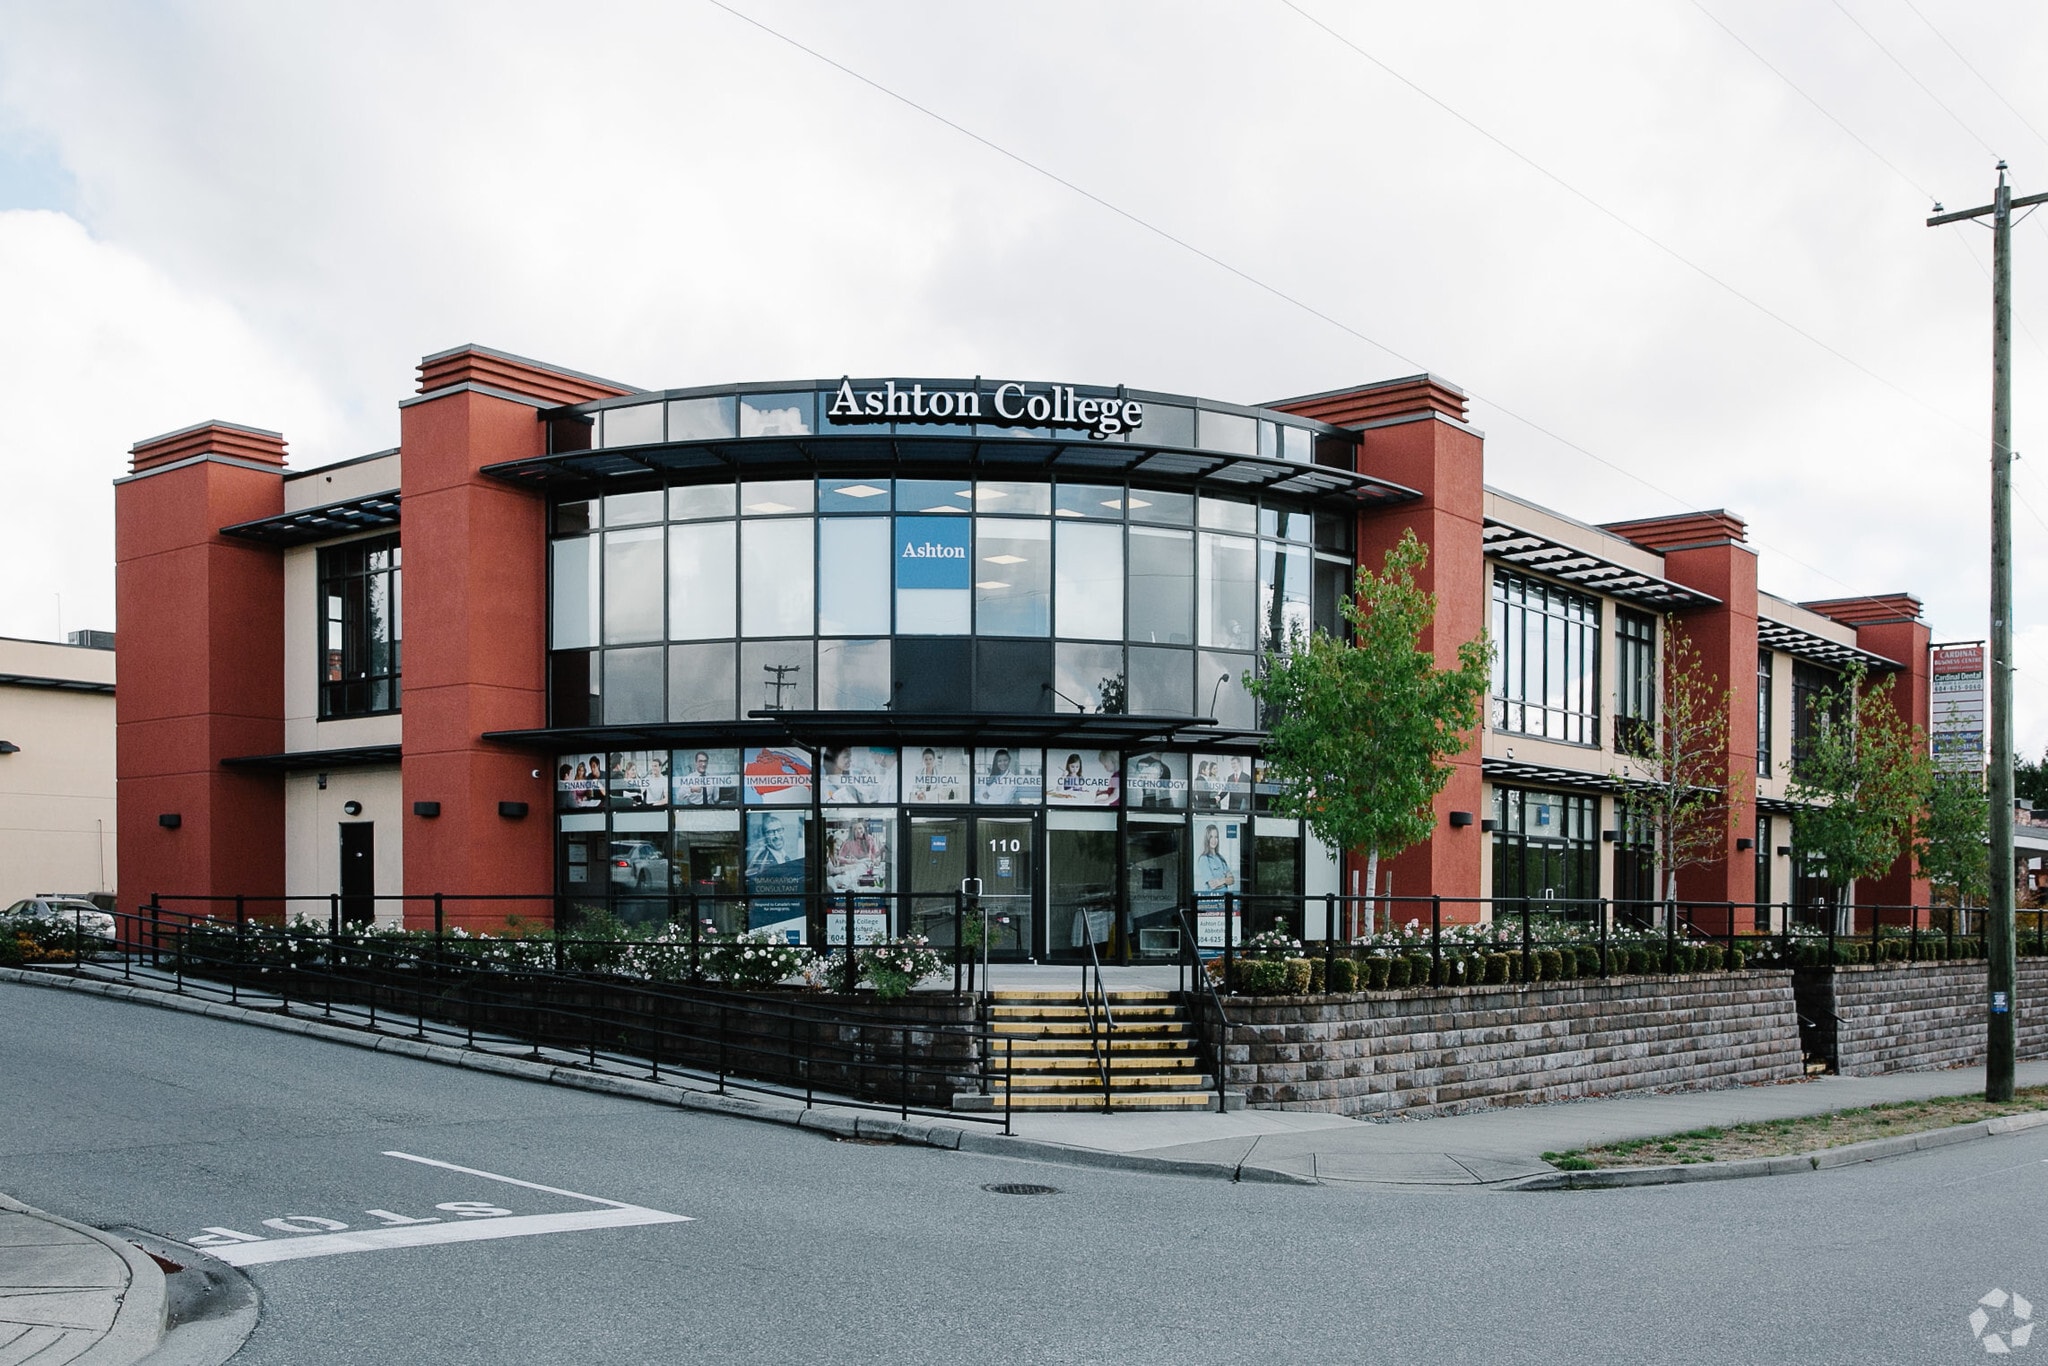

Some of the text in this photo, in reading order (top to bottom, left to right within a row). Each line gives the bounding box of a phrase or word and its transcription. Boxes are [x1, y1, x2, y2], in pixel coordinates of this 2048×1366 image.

[828, 380, 1143, 434] Ashton College
[902, 542, 966, 559] Ashton
[1939, 649, 1977, 659] CARDINAL
[1934, 671, 1982, 681] Cardinal Dental
[627, 779, 650, 787] SALES
[680, 777, 732, 786] MARKETING
[747, 775, 813, 785] IMMIGRATION
[840, 775, 879, 784] DENTAL
[915, 776, 959, 784] MEDICAL
[977, 776, 1042, 785] HEALTHCARE
[1057, 777, 1109, 787] CHILDCARE
[1127, 779, 1186, 789] TECHNOLOGY
[564, 781, 601, 789] FINANCIAL
[1204, 782, 1241, 791] BUSINESS
[989, 839, 1020, 852] 110
[755, 885, 798, 893] CONSULTANT
[856, 918, 879, 926] College
[188, 1201, 513, 1247] STOP
